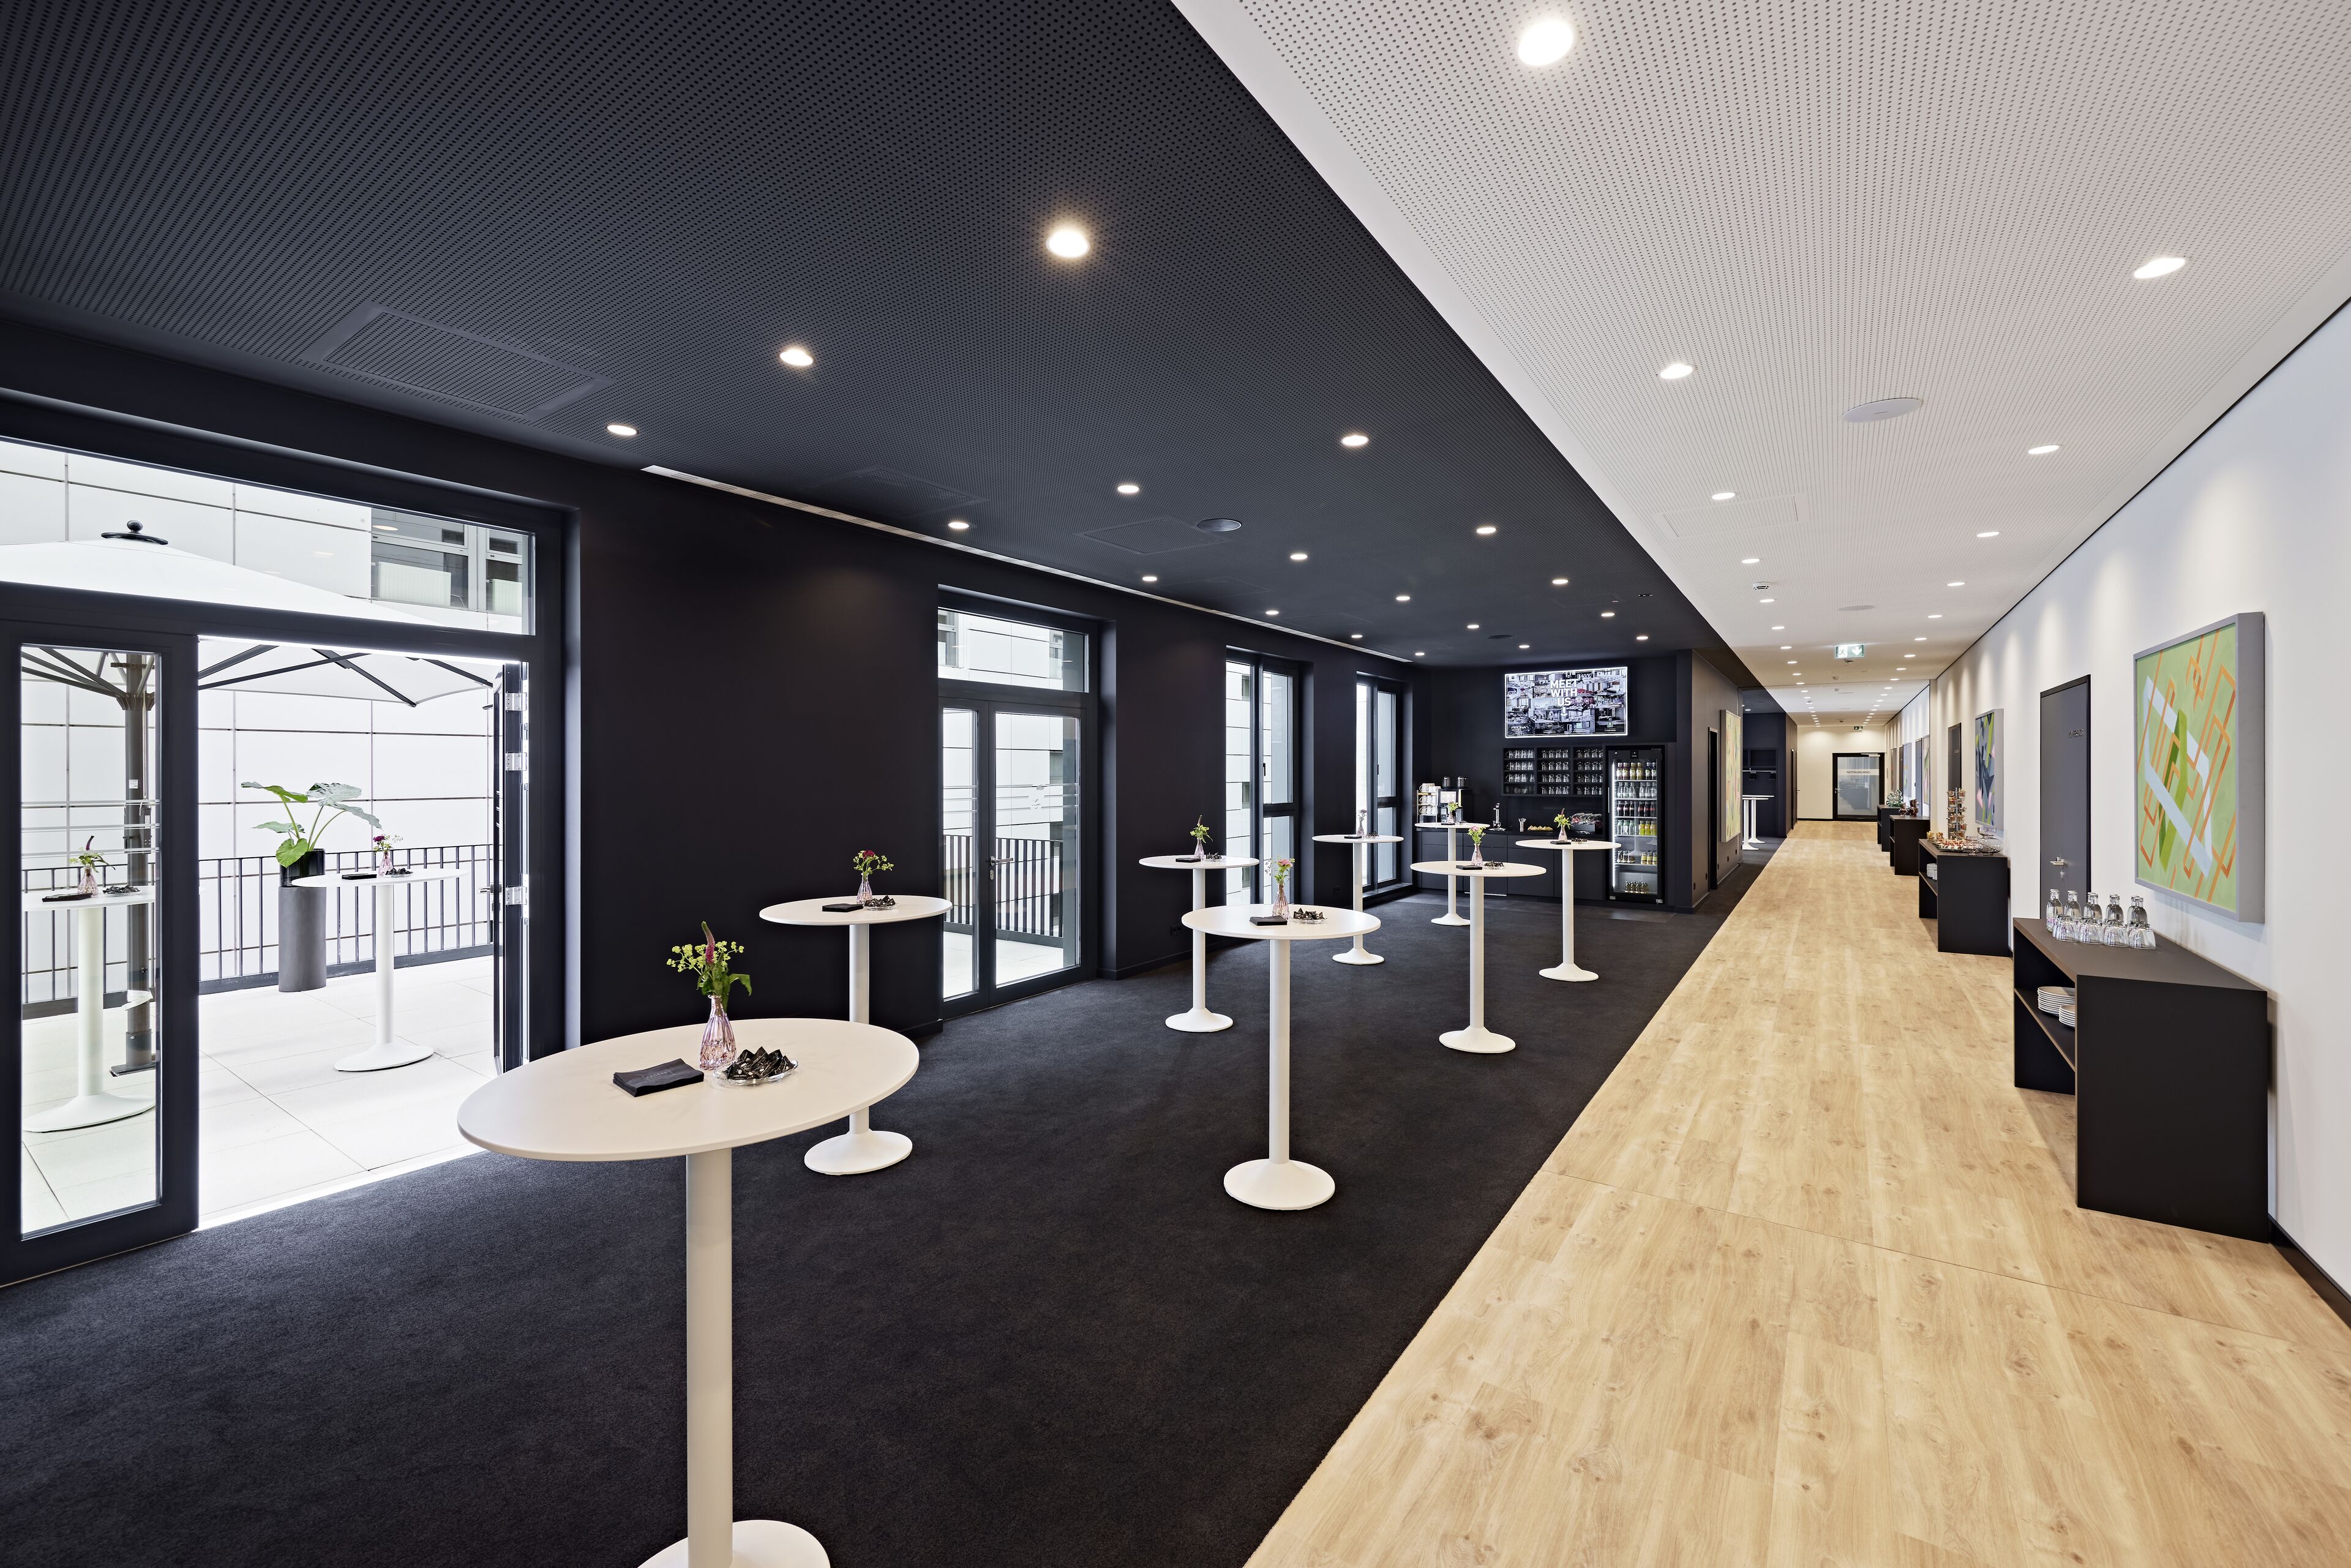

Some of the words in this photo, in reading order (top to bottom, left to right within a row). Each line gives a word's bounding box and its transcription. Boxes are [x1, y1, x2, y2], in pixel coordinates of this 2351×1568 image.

[1550, 679, 1578, 689] MEET
[1550, 688, 1578, 697] WITH
[1558, 697, 1572, 706] US
